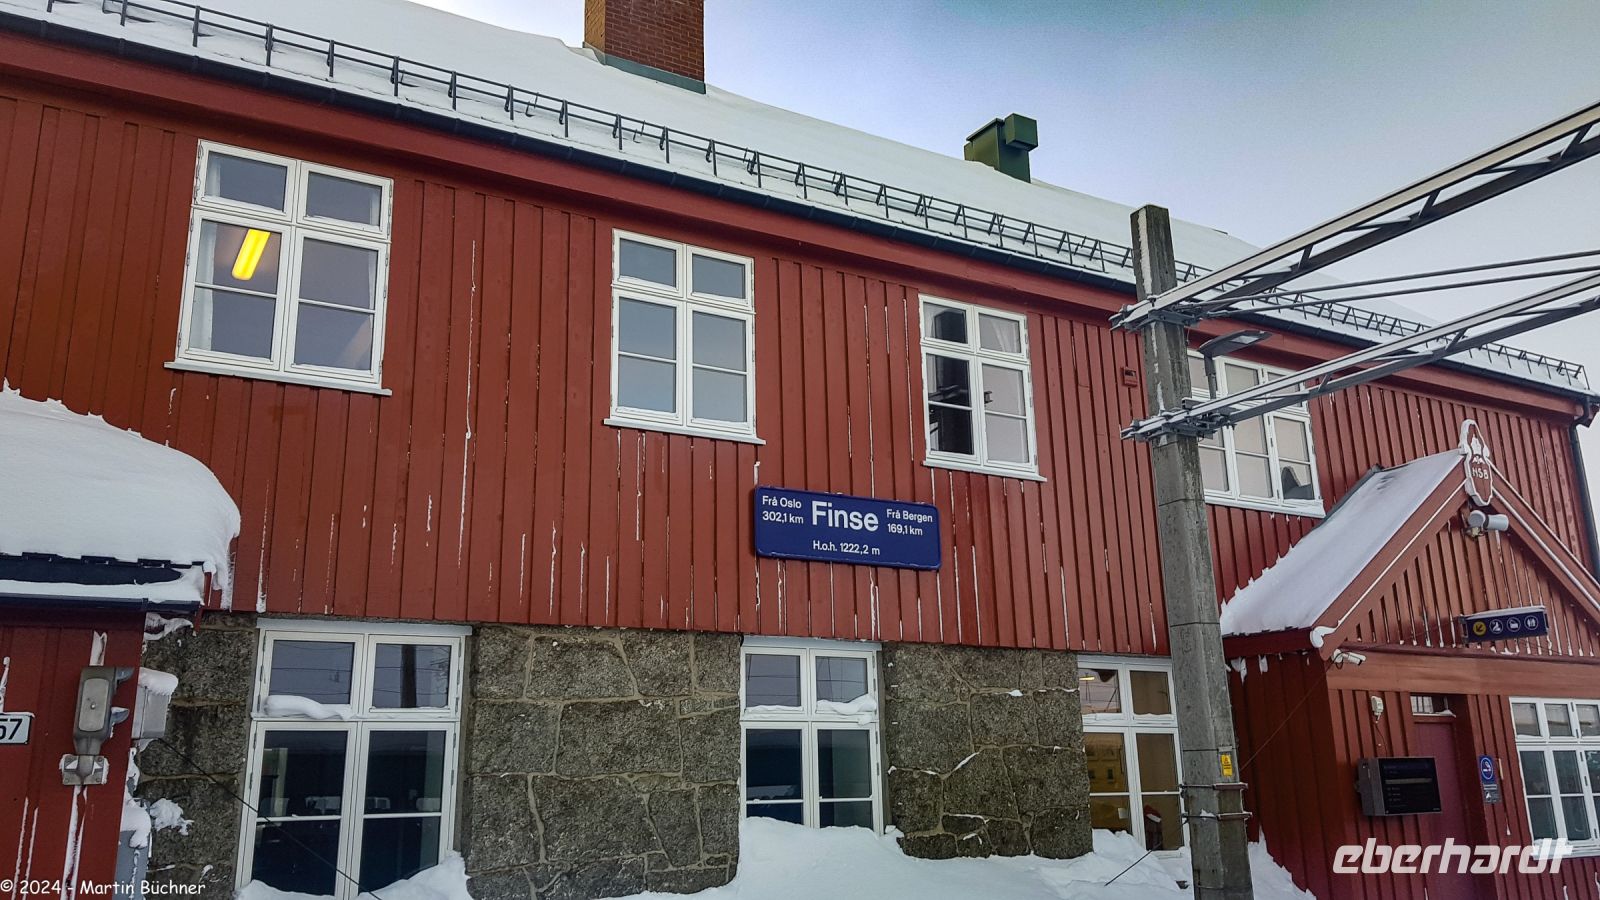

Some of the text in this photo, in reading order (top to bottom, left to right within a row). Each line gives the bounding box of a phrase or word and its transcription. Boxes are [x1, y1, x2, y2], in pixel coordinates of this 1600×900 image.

[762, 495, 802, 509] Frå Oslo
[762, 511, 804, 525] 302,1 km
[812, 500, 879, 532] Finse
[886, 508, 933, 524] Frå Bergen
[887, 523, 923, 536] 169,1 km
[813, 540, 881, 556] H.o.h. 1222,2 m
